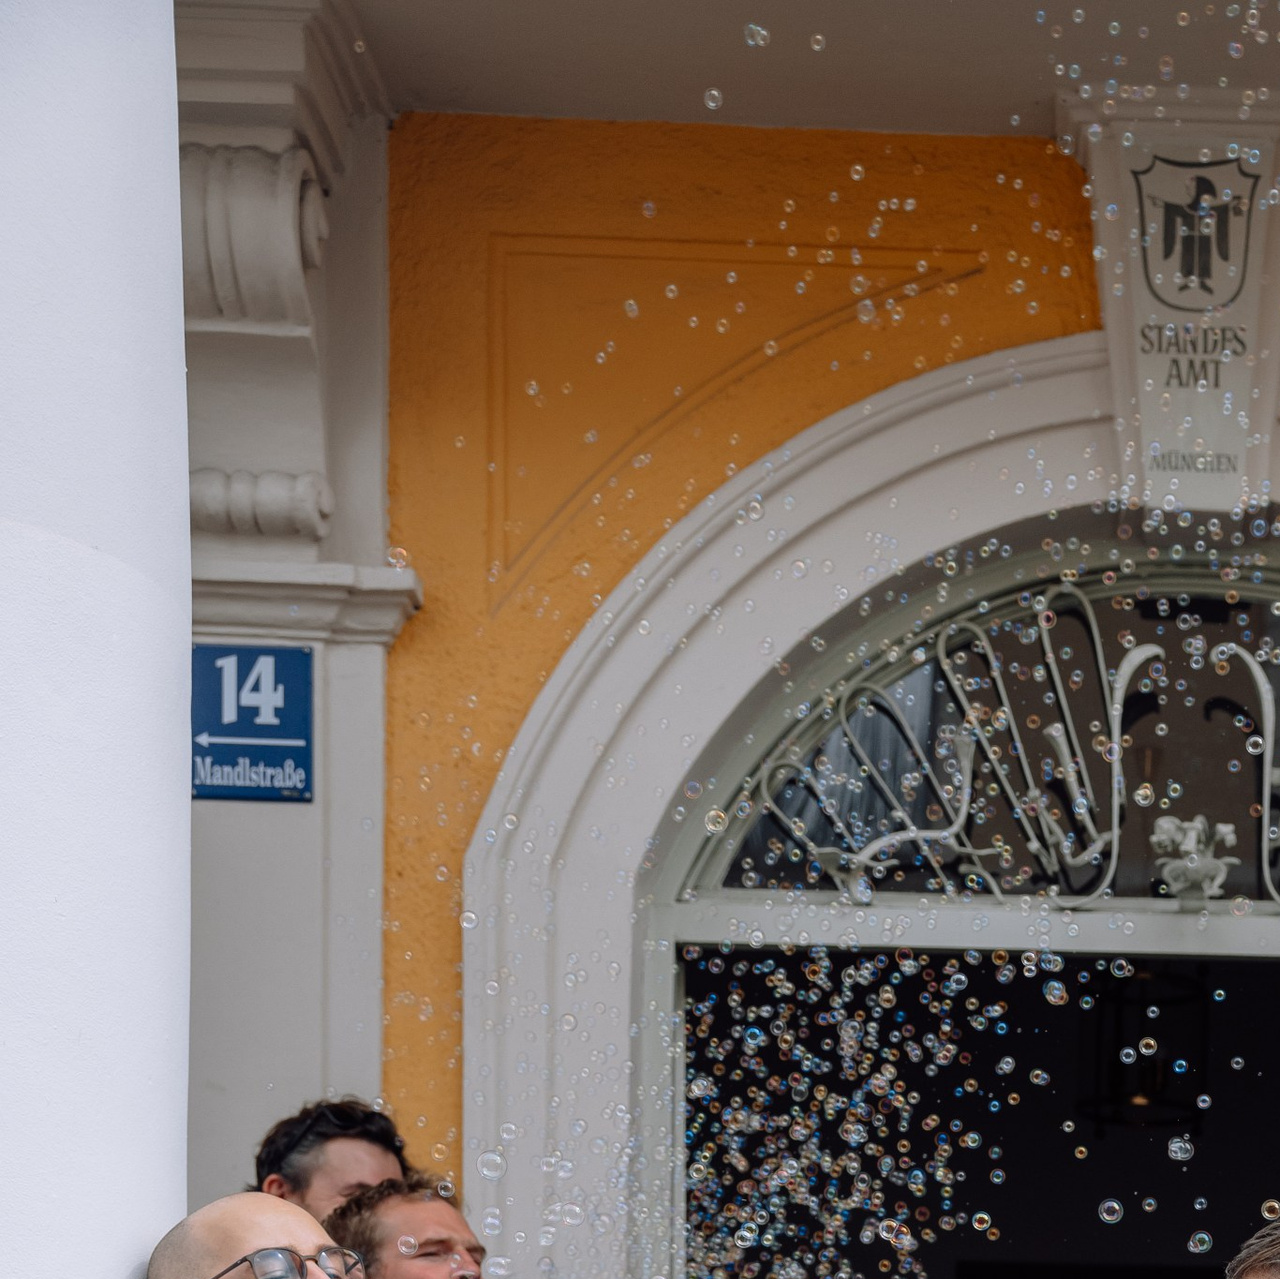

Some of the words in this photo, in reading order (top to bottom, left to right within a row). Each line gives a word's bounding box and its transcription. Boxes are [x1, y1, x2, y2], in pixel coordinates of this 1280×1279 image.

[1140, 324, 1247, 357] STANDES
[1165, 358, 1224, 389] AMT
[1149, 450, 1238, 473] MÜNCHEN
[214, 654, 285, 726] 14
[194, 755, 306, 789] Mandlstraße
